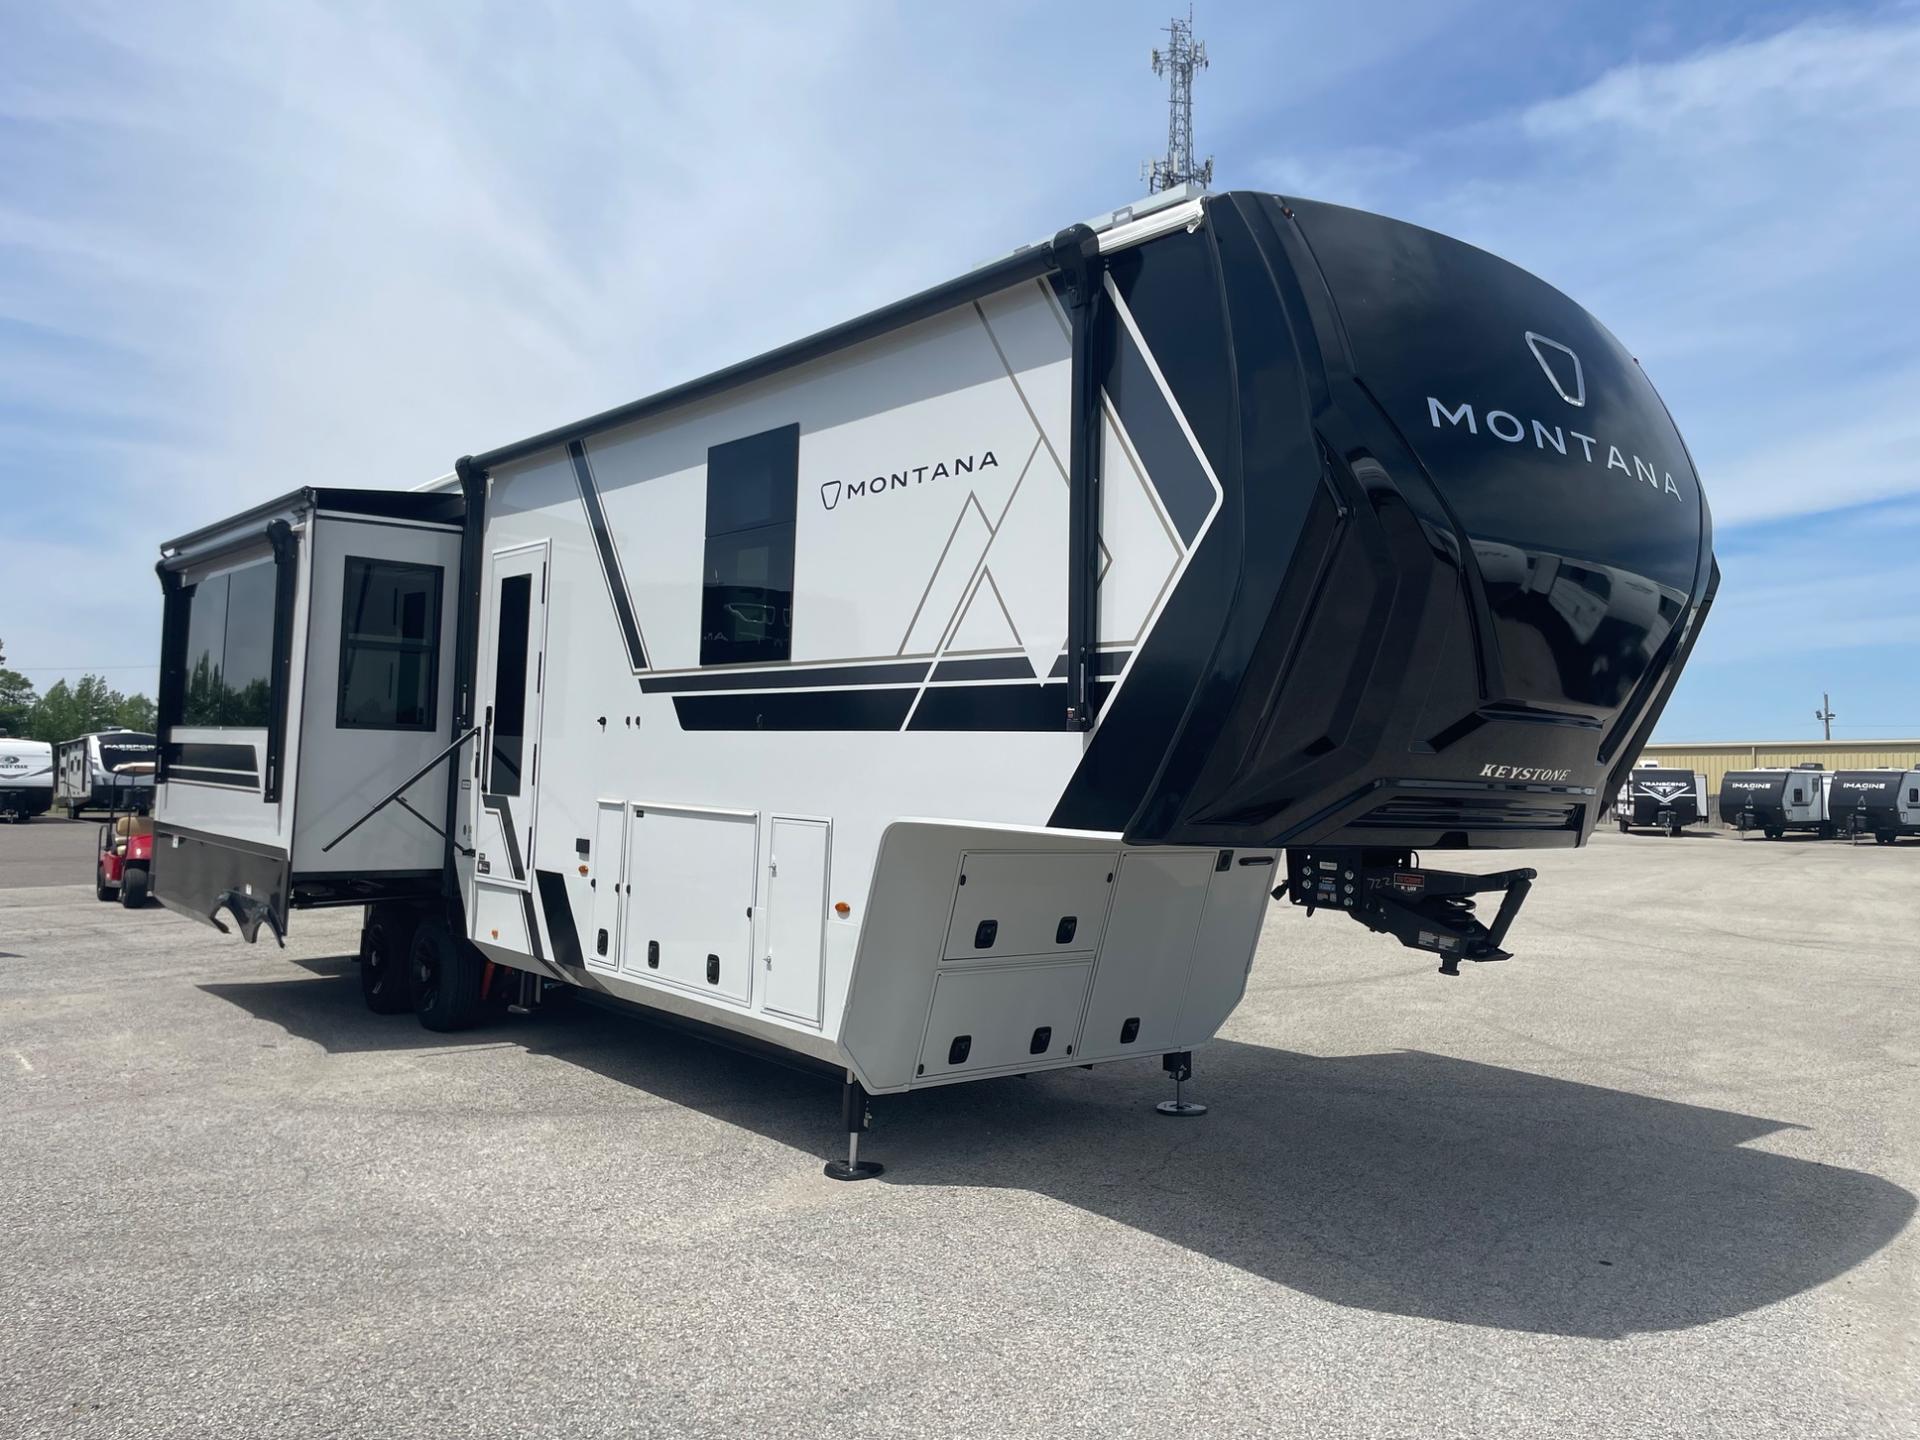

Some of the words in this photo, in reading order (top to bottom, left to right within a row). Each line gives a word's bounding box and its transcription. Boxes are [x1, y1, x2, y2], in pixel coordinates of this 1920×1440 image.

[1427, 397, 1682, 502] MONTANA
[847, 451, 998, 499] MONTANA
[1480, 764, 1571, 781] KEYSTONE
